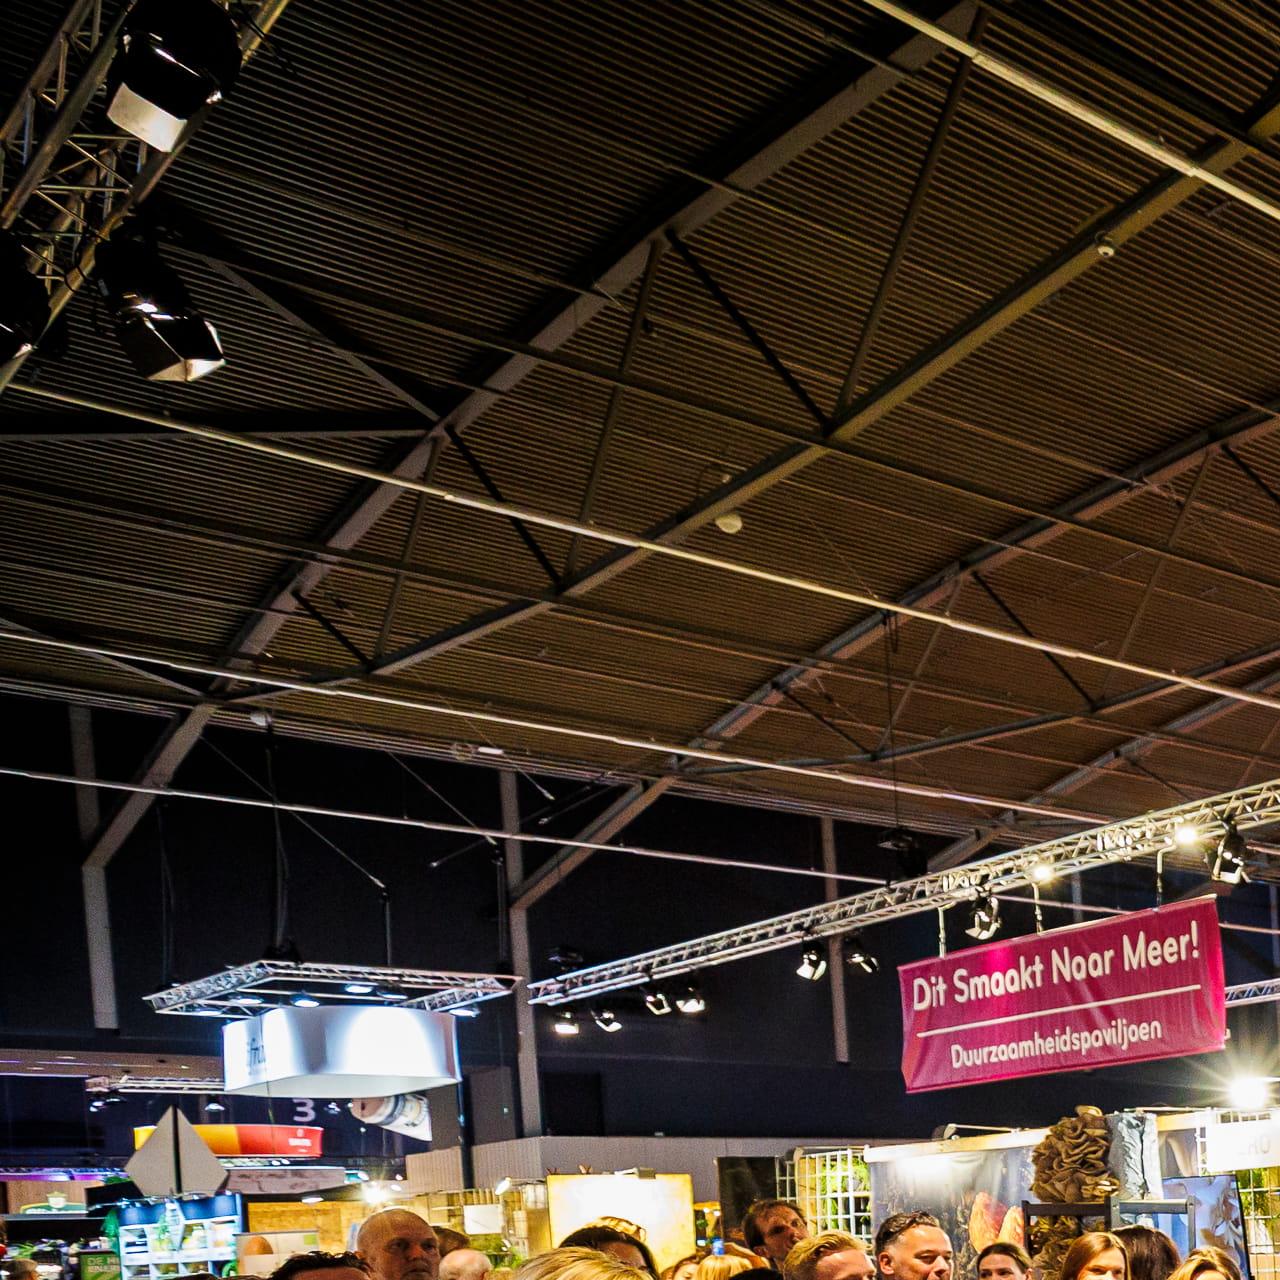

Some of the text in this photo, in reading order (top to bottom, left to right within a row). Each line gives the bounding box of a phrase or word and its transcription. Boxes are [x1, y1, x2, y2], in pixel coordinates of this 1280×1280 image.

[912, 919, 1200, 1011] Dit Smaakt Naar Meer!
[951, 1019, 1163, 1069] Duurzaamheidspaviljoen
[292, 1098, 316, 1122] 3
